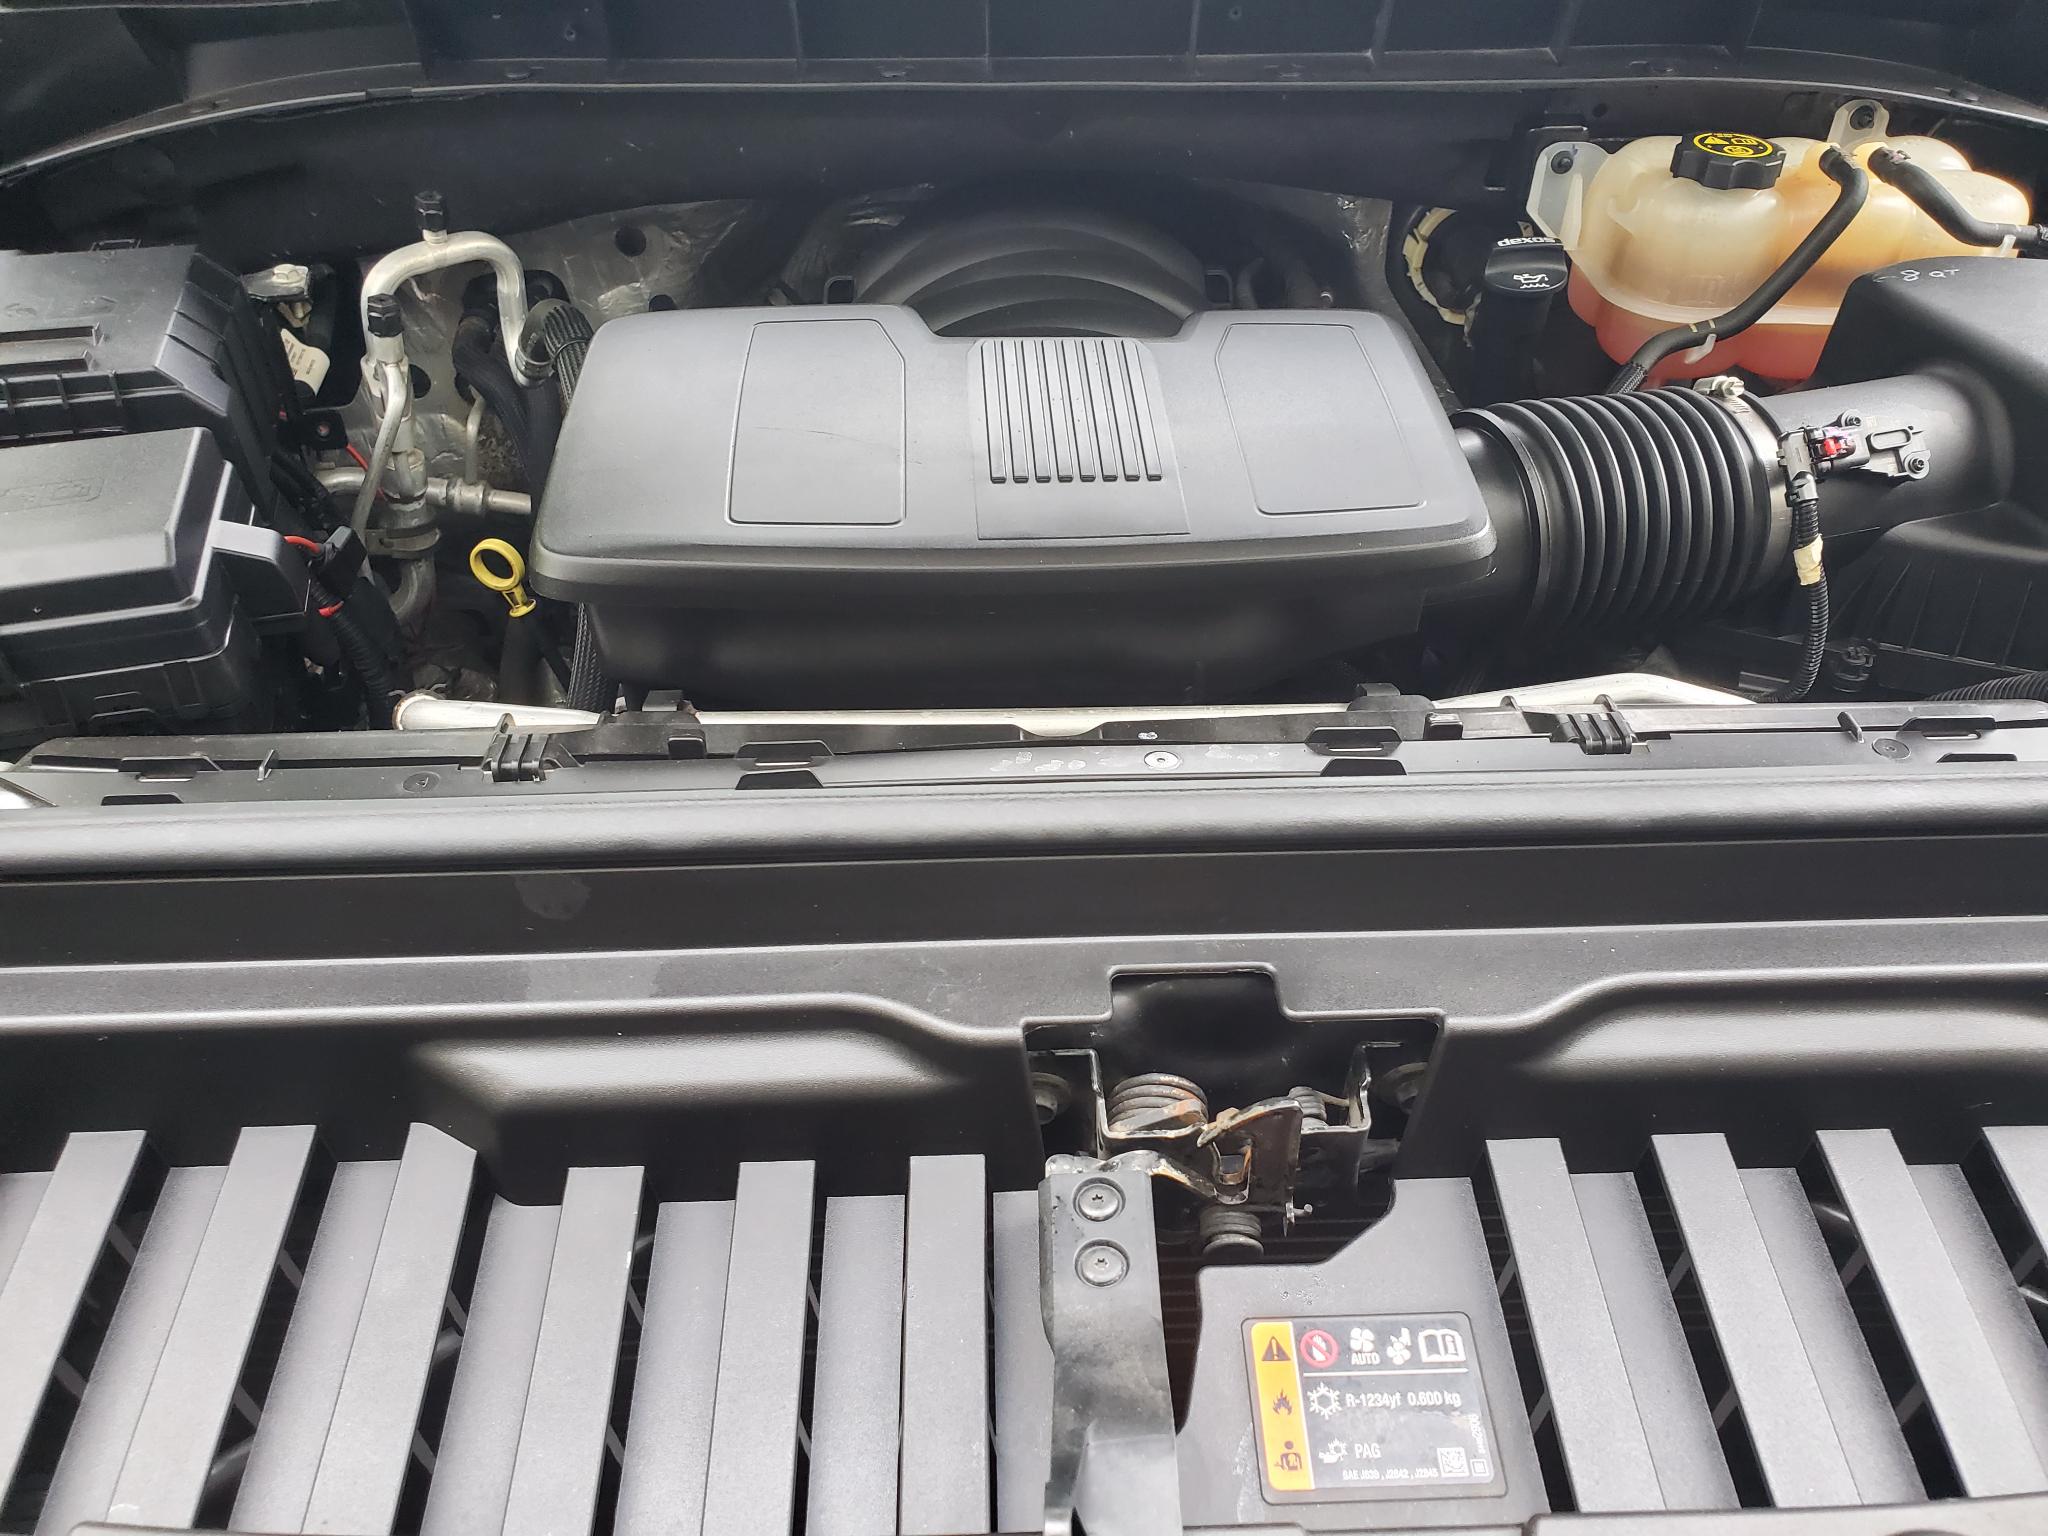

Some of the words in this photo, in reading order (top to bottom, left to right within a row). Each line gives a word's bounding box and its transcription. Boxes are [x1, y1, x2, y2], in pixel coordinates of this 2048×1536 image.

[1497, 236, 1556, 247] dexos
[1351, 1352, 1381, 1366] AUTO
[1346, 1392, 1401, 1410] R-1234yf
[1443, 1390, 1462, 1408] kg
[1354, 1443, 1382, 1459] PAG
